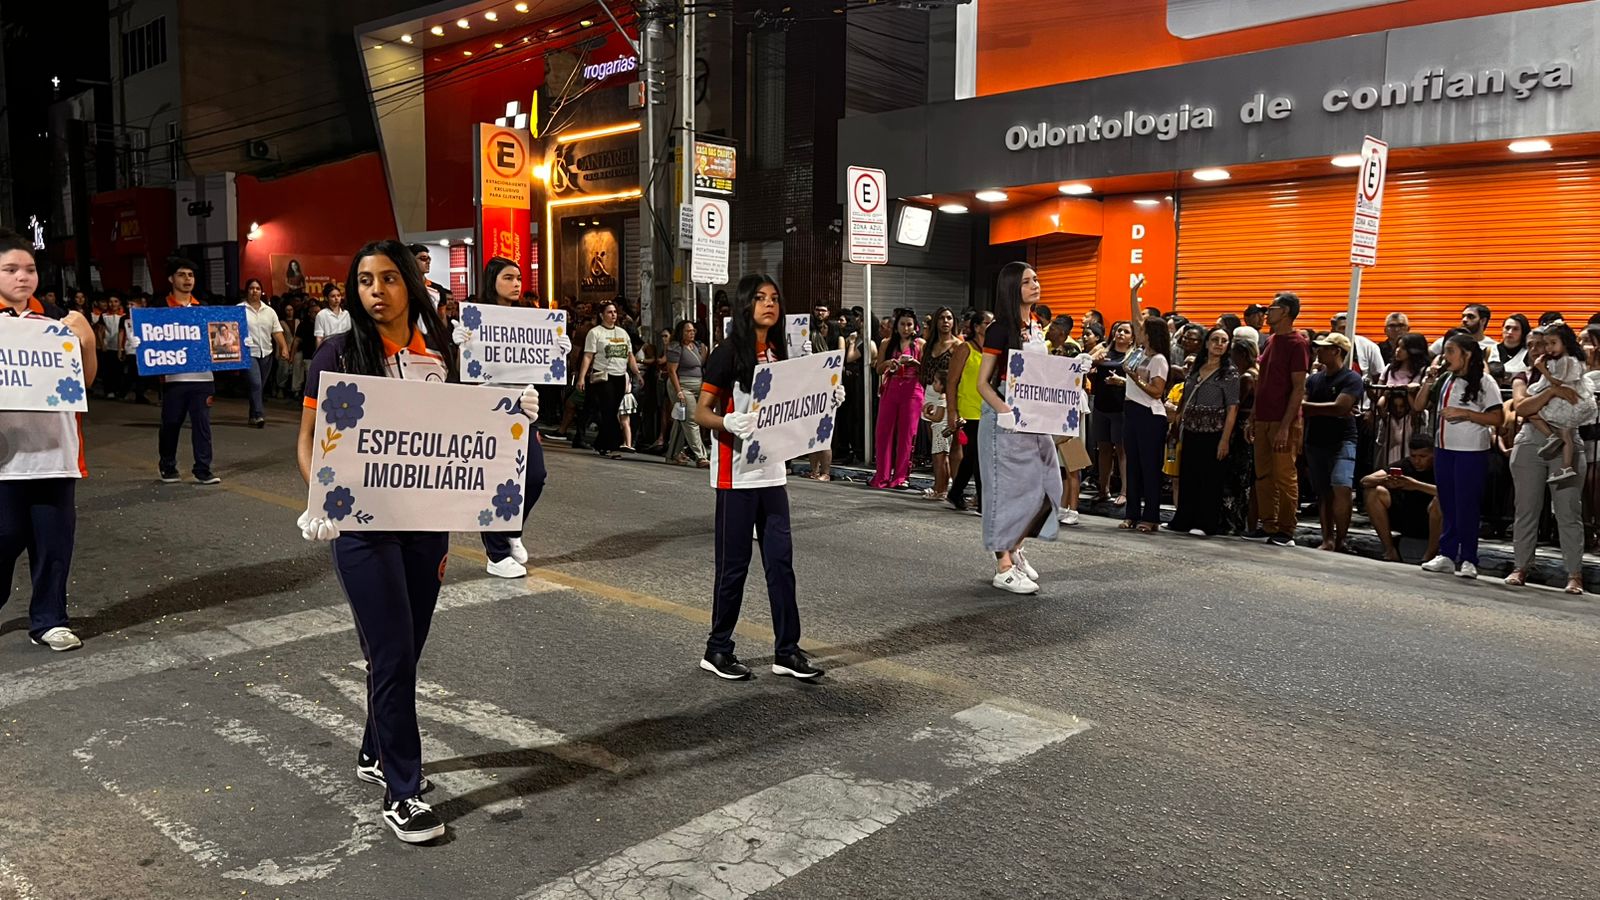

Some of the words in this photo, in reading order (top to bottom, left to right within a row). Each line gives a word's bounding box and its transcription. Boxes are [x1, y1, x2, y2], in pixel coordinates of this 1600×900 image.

[1005, 104, 1214, 151] Odontologia
[1240, 93, 1293, 124] de
[1322, 63, 1573, 113] confiança
[496, 140, 515, 169] E
[862, 183, 872, 203] E
[707, 211, 716, 229] E
[141, 322, 201, 342] Regina
[480, 325, 554, 346] HIERARQUIA
[0, 348, 65, 369] ALDADE
[144, 347, 187, 367] Casé
[485, 346, 501, 363] DE
[504, 347, 550, 365] CLASSE
[1014, 383, 1076, 406] PERTENCIMENTO
[757, 392, 828, 429] CAPITALISMO
[357, 428, 497, 463] ESPECULAÇÃO
[364, 460, 485, 490] IMOBILIÁRIA
